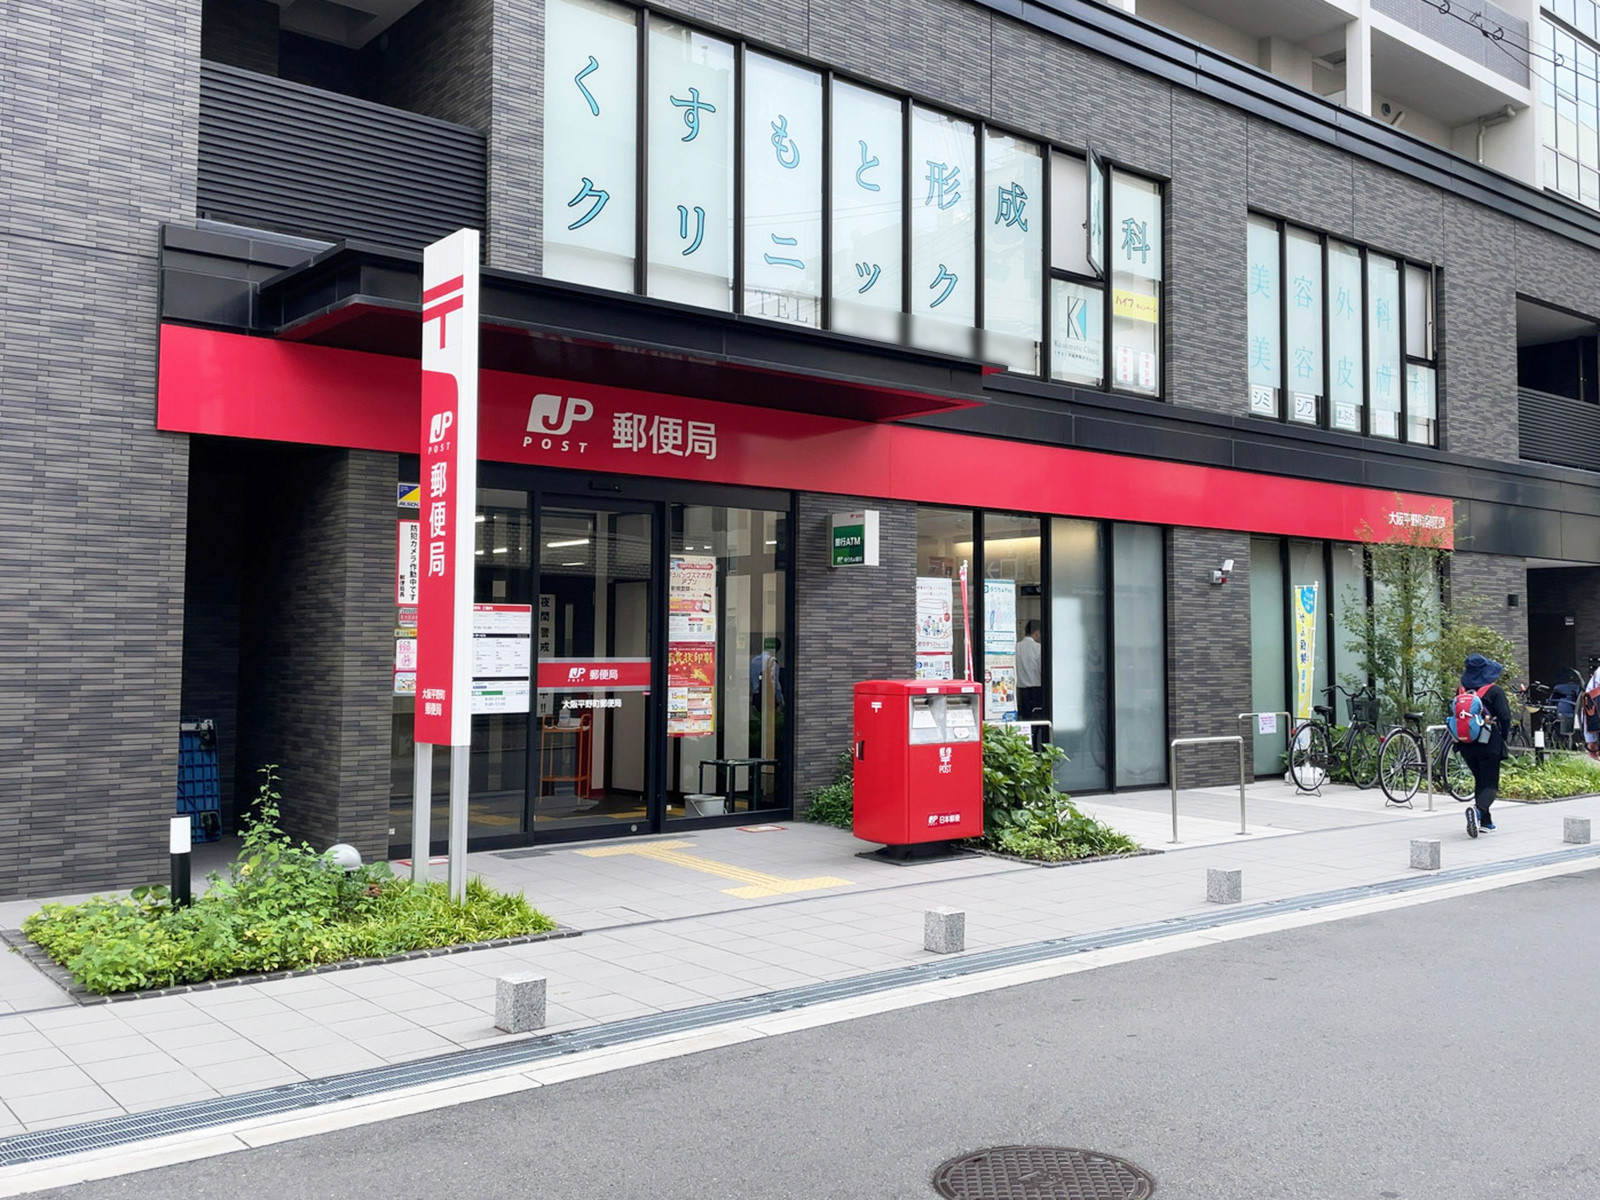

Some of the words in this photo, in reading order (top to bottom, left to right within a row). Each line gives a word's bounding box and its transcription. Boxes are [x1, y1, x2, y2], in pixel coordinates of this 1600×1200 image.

[1253, 391, 1270, 408] シミ
[1297, 398, 1314, 414] シワ
[526, 393, 594, 435] JP
[429, 411, 453, 443] JP
[612, 411, 717, 460] 郵便局
[428, 442, 450, 455] POST
[523, 436, 587, 453] POST
[428, 461, 448, 577] 郵便局
[569, 667, 586, 680] JP
[589, 669, 619, 681] 郵便局
[562, 698, 622, 709] 大阪平野町郵便局
[939, 765, 952, 773] POST
[939, 814, 961, 825] 日本郵便
